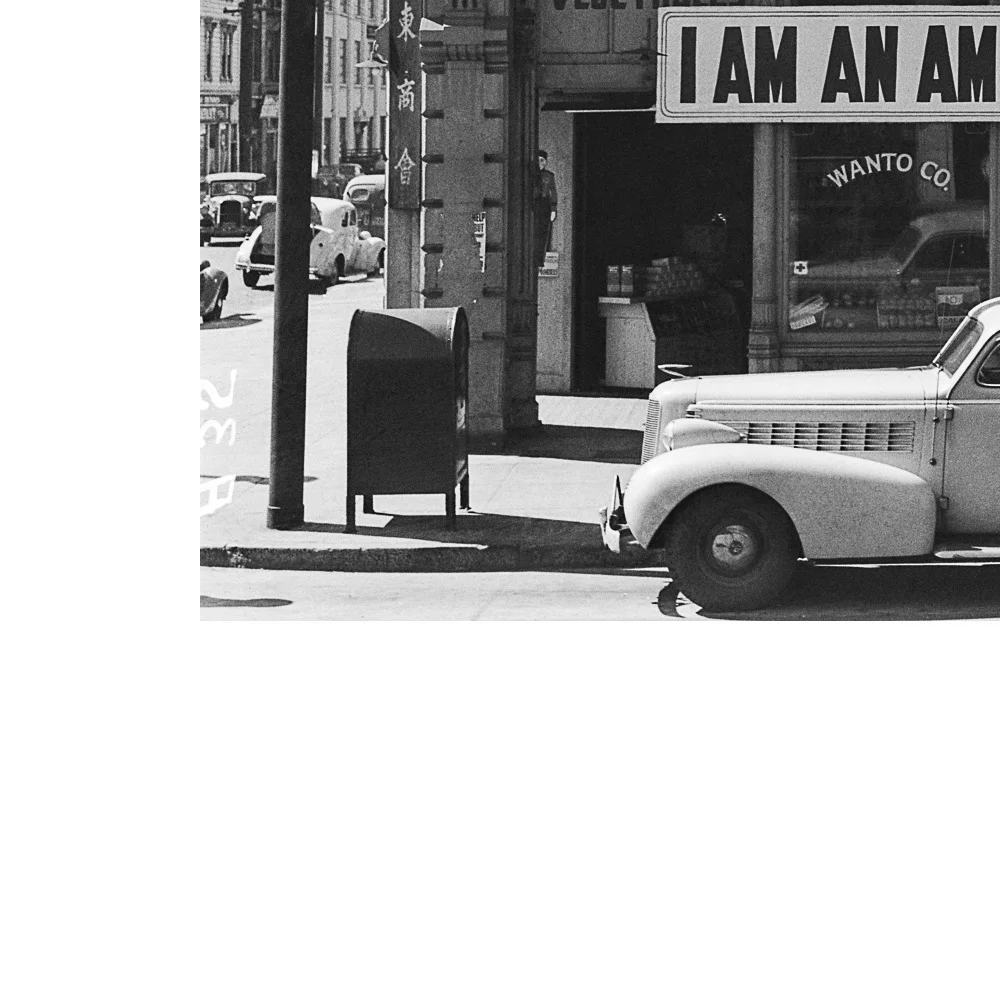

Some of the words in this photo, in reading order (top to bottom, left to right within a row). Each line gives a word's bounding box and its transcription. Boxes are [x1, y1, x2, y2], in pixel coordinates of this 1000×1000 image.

[679, 26, 698, 104] I
[712, 25, 798, 104] AM
[820, 25, 899, 104] AN
[826, 152, 914, 189] WANTO
[920, 160, 953, 193] CO.
